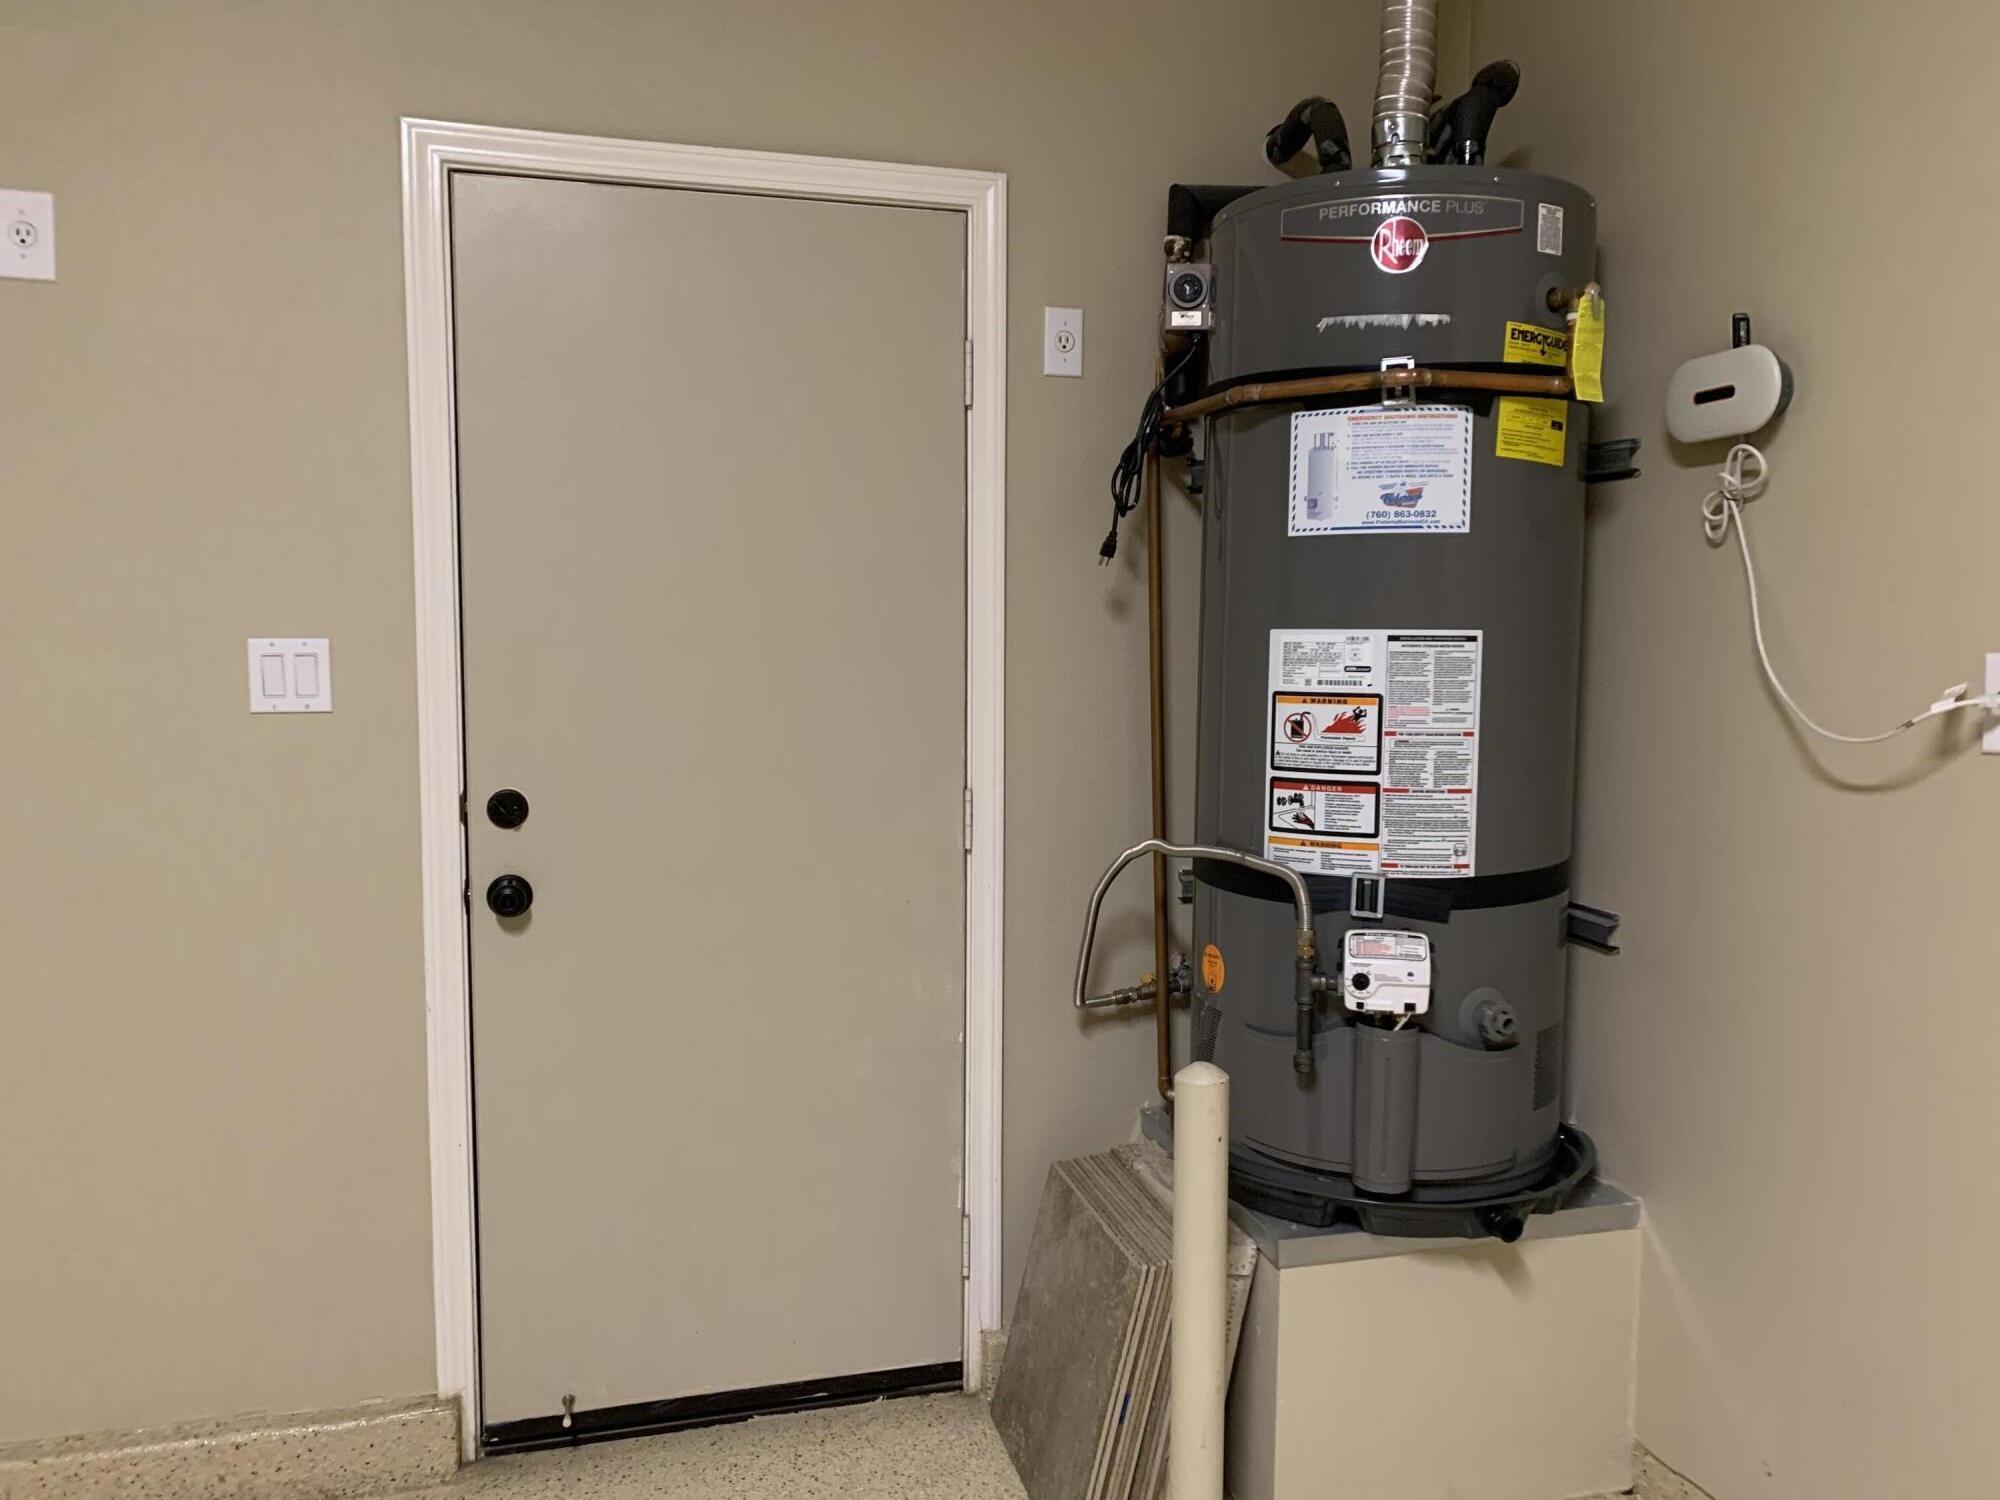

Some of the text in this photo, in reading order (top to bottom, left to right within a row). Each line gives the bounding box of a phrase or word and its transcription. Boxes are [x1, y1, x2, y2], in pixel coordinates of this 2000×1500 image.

[1319, 200, 1485, 220] PERFORMANCE PLUS
[1378, 219, 1425, 264] Rheem
[1366, 509, 1437, 519] (760) 863-0832
[1310, 784, 1342, 792] DANGER
[1310, 840, 1342, 849] WARNING
